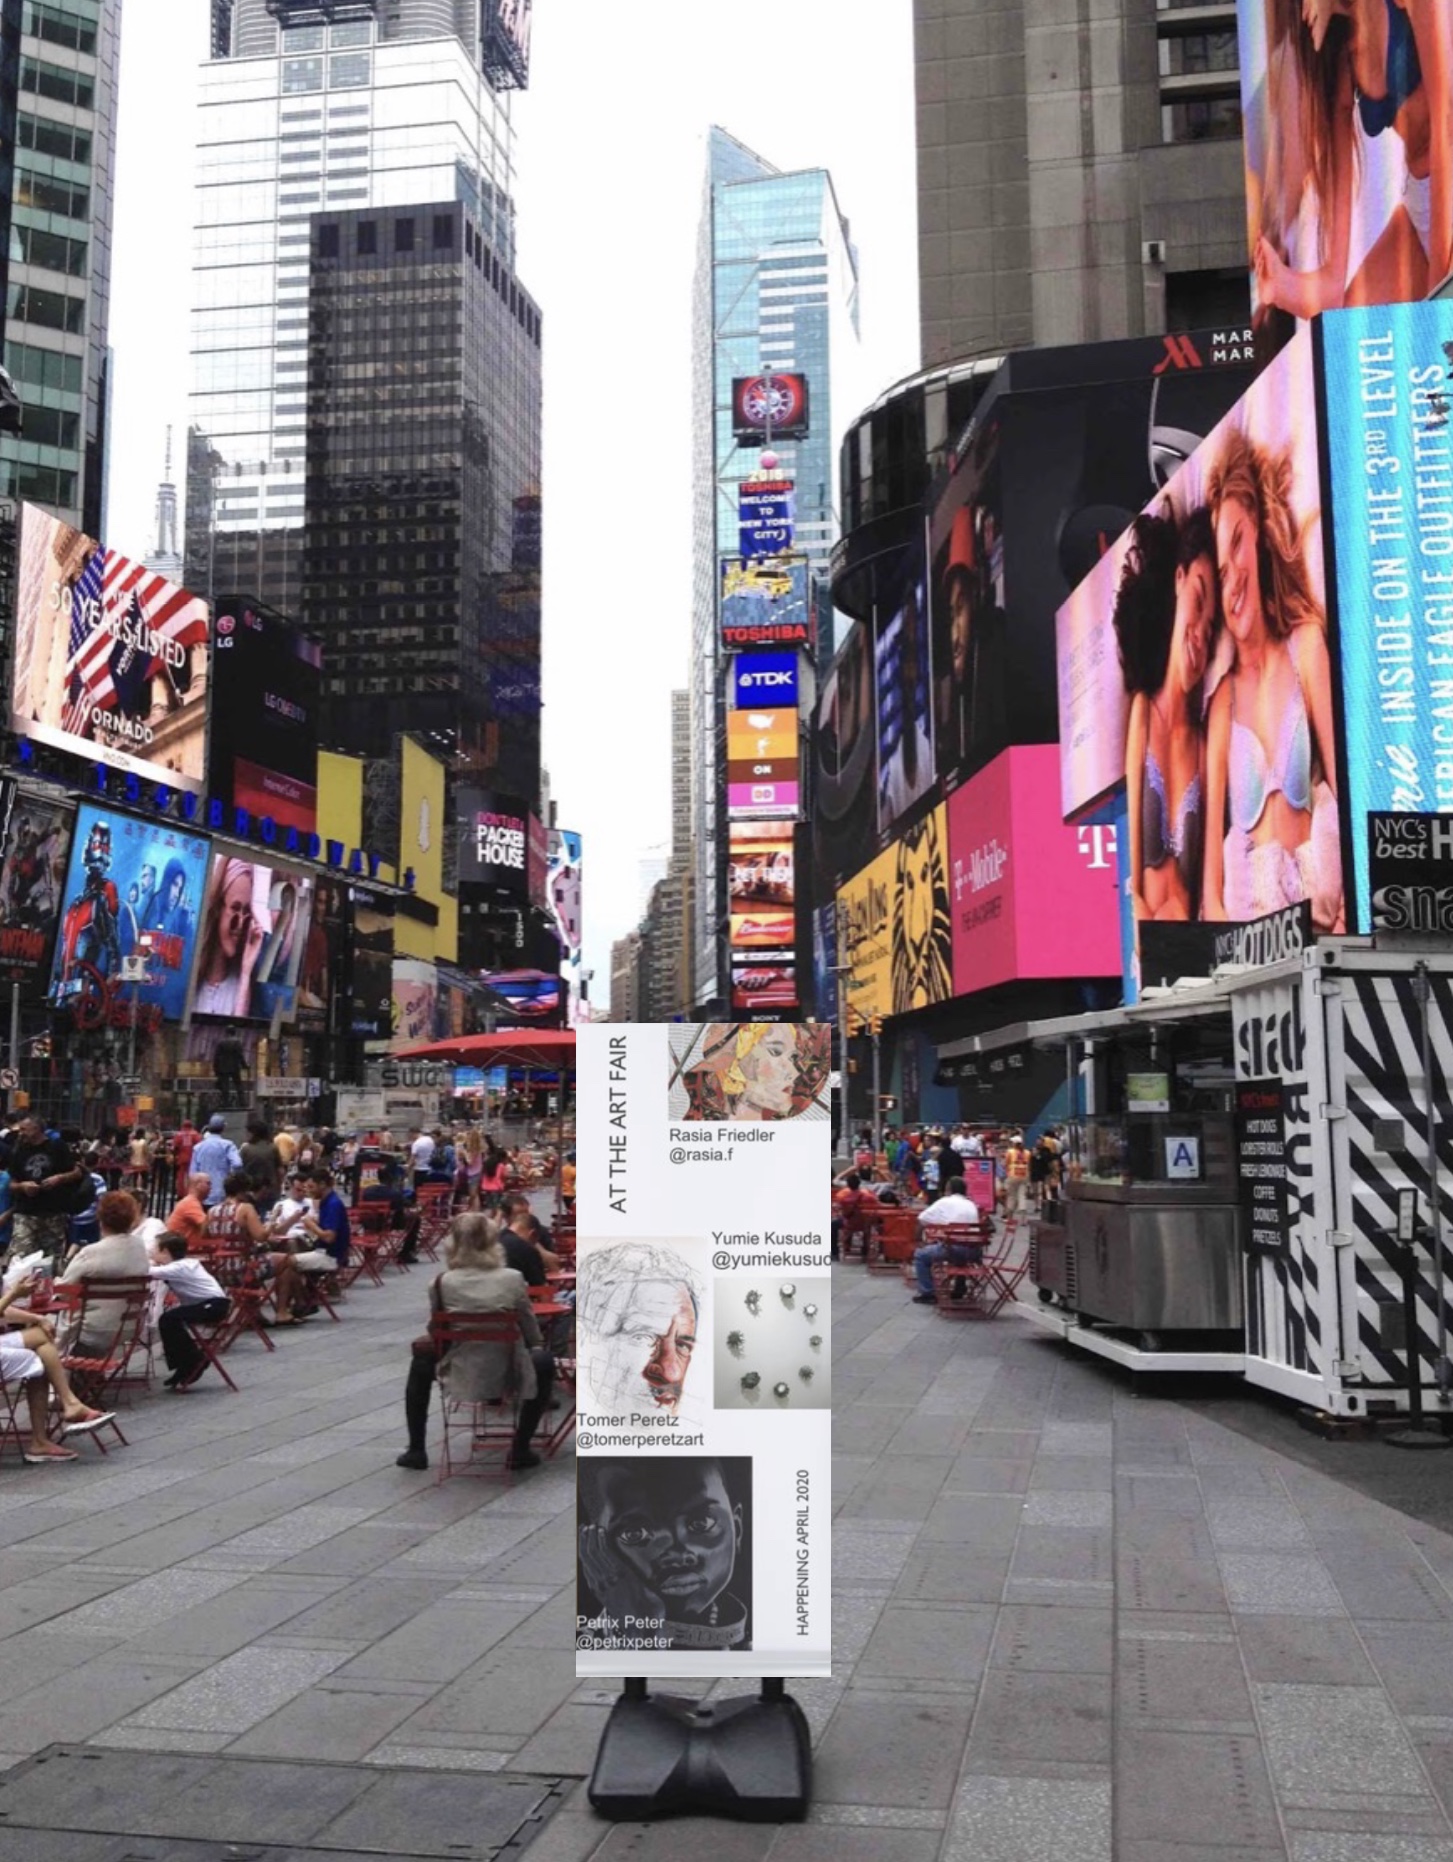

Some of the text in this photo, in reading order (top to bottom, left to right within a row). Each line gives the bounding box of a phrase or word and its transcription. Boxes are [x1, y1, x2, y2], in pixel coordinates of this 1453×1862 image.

[1357, 330, 1398, 420] LEVEL
[1367, 485, 1406, 546] THE
[1372, 556, 1410, 601] ON
[216, 637, 234, 648] LG
[723, 624, 807, 643] TOSHIBA
[1375, 611, 1417, 724] INSIDE
[750, 671, 795, 686] TDK
[752, 764, 772, 775] ON
[1373, 818, 1427, 839] NYC's
[208, 799, 382, 877] BROADWAY
[477, 841, 525, 870] HOUSE
[1375, 838, 1428, 859] best
[1232, 923, 1264, 966] HOT
[1263, 905, 1303, 966] DOGS
[751, 1015, 781, 1023] SONY
[609, 1035, 627, 1214] AT THE ART FAIR
[669, 1128, 775, 1142] Rasia Friedler
[669, 1147, 734, 1164] @rasia.f
[1172, 1142, 1194, 1167] A
[1253, 1185, 1276, 1200] COFFEE
[1253, 1207, 1279, 1223] DONUTS
[711, 1231, 822, 1246] Yumie Kusuda
[1252, 1228, 1282, 1246] PRETZELS
[577, 1413, 679, 1428] Tomer Peretz
[577, 1432, 704, 1449] @tomerperetzart
[796, 1469, 810, 1636] HAPPENING APRIL 2020
[576, 1615, 665, 1629] Petrix Peter
[576, 1636, 674, 1651] @petrixpeter
